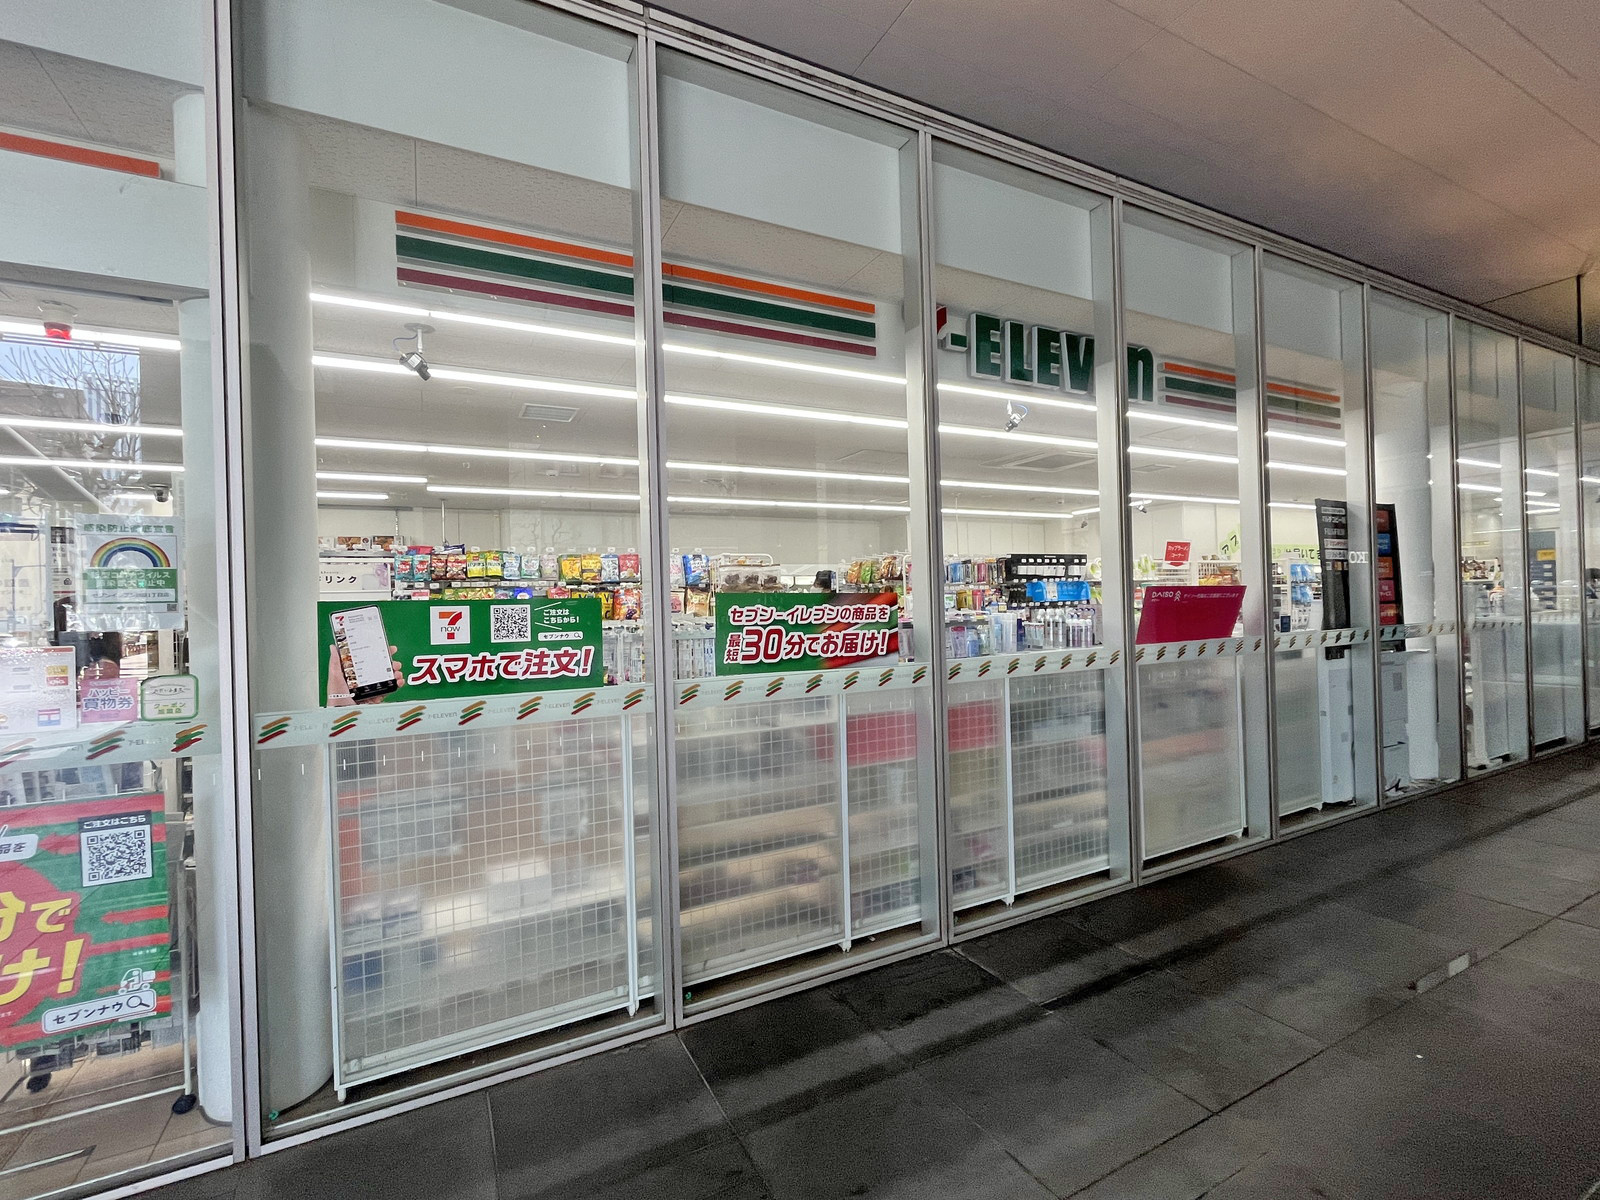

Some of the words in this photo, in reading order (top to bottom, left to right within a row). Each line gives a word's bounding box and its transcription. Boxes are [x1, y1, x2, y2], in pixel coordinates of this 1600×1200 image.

[936, 305, 1154, 403] -ELEVn
[319, 575, 357, 584] リンク
[543, 608, 570, 616] ご注文は
[408, 648, 593, 684] スマホで注文!
[90, 689, 130, 697] ハッピー
[83, 697, 133, 710] 買物券
[83, 814, 147, 829] ご注文はこちら
[53, 1001, 124, 1025] セブンナウ
